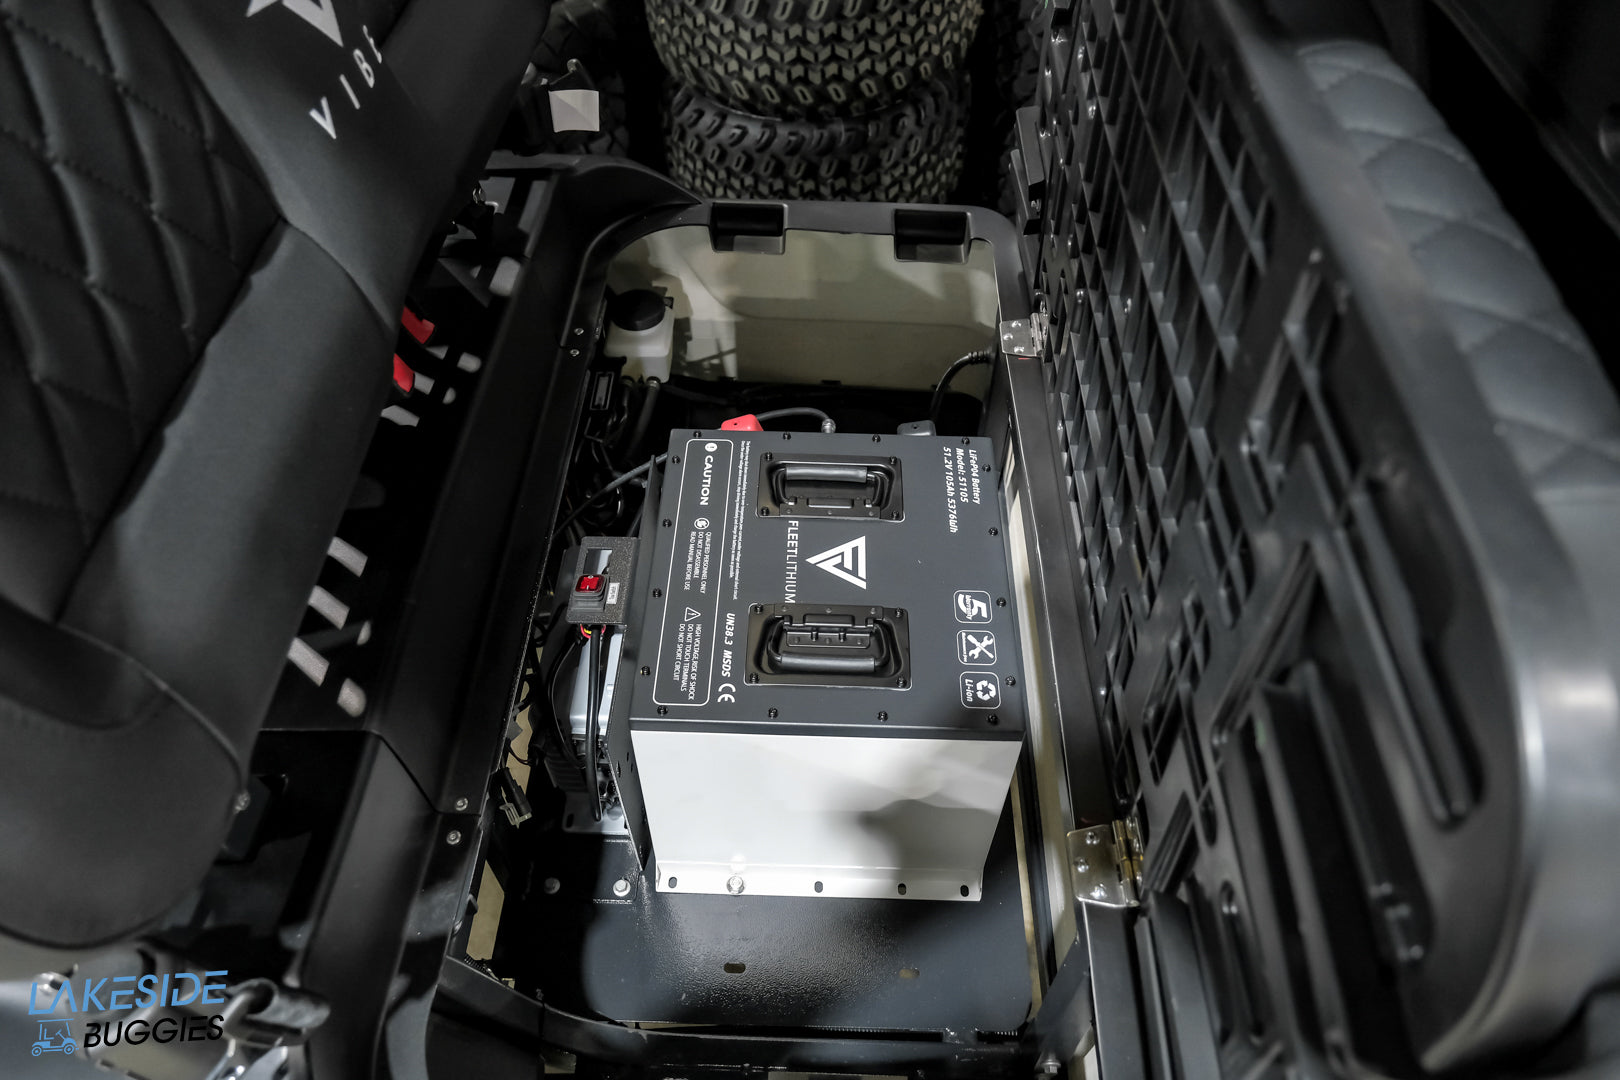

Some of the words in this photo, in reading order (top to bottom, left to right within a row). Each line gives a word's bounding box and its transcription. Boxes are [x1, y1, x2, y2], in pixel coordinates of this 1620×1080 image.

[309, 24, 382, 140] VIBE
[943, 446, 953, 470] 51.2V
[956, 448, 965, 475] Model:
[700, 455, 713, 506] CAUTION
[945, 471, 955, 496] 105Ah
[958, 476, 968, 503] 51105
[972, 478, 980, 504] Battery
[948, 498, 958, 533] 5376Wh
[693, 550, 701, 578] DISASSEMBLE
[701, 555, 709, 580] PERSONNEL
[784, 520, 799, 604] FLEETLITHIUM
[958, 594, 988, 618] 5
[724, 613, 735, 645] UN38.3
[673, 661, 681, 680] CIRCUIT
[721, 649, 732, 677] MSDS
[681, 663, 689, 691] TERMINALS
[965, 679, 974, 702] Li-ion
